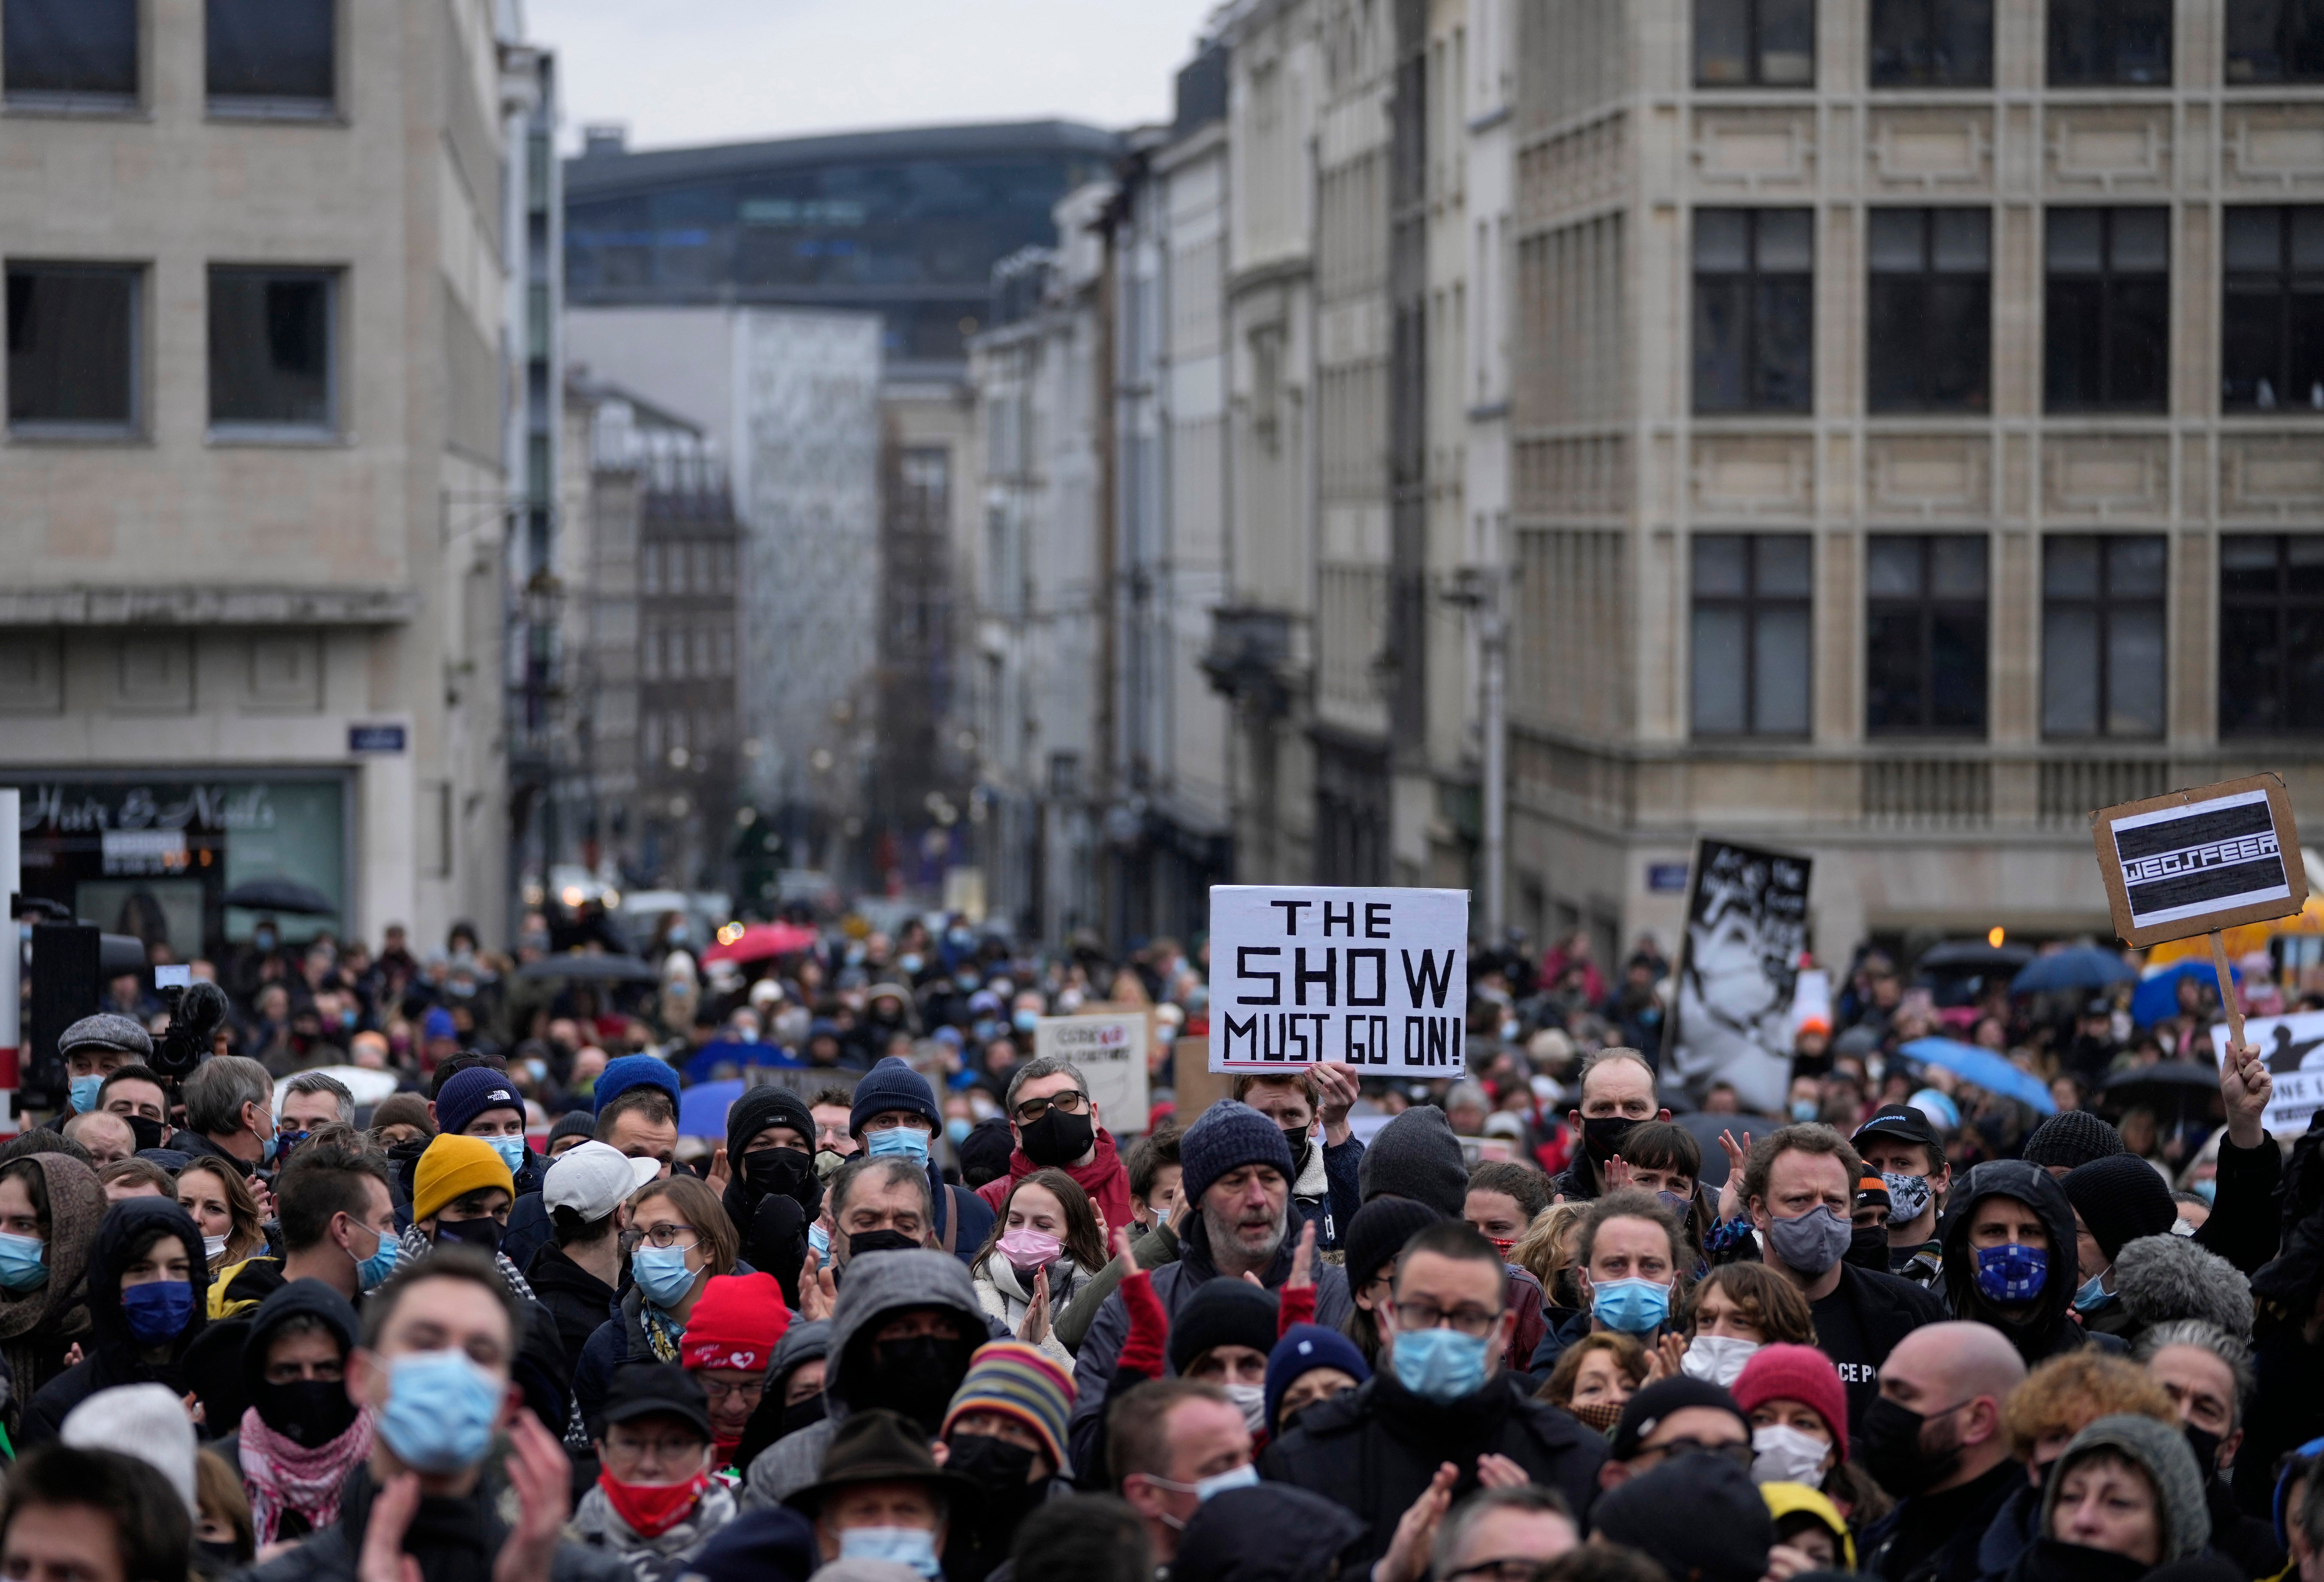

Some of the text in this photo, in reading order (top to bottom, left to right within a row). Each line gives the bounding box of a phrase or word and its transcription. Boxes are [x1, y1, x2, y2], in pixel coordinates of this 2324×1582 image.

[1271, 901, 1391, 938] THE
[1237, 946, 1455, 1008] SHOW
[1224, 1011, 1460, 1066] MUST GO ON!
